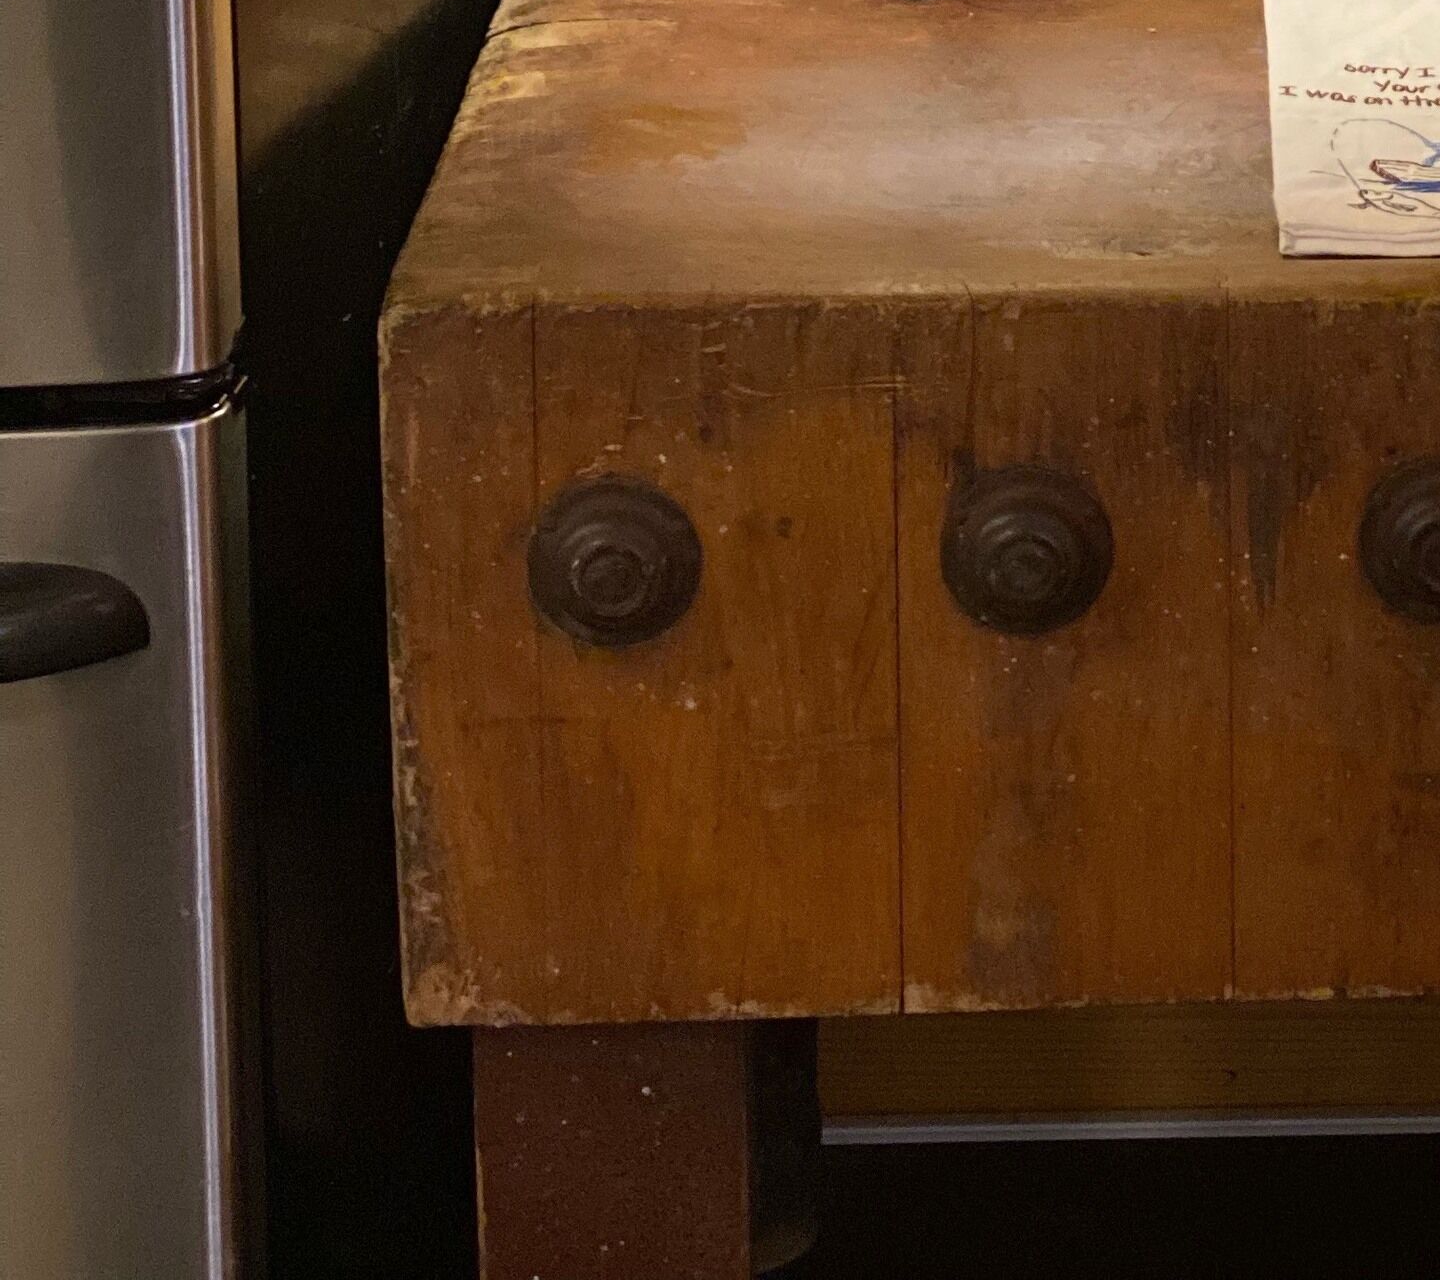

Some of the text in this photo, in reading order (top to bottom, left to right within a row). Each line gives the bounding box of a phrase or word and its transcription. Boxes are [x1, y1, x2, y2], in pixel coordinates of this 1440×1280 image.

[1416, 66, 1436, 78] I
[1278, 85, 1298, 96] I
[1305, 89, 1358, 103] was
[1364, 96, 1394, 105] on
